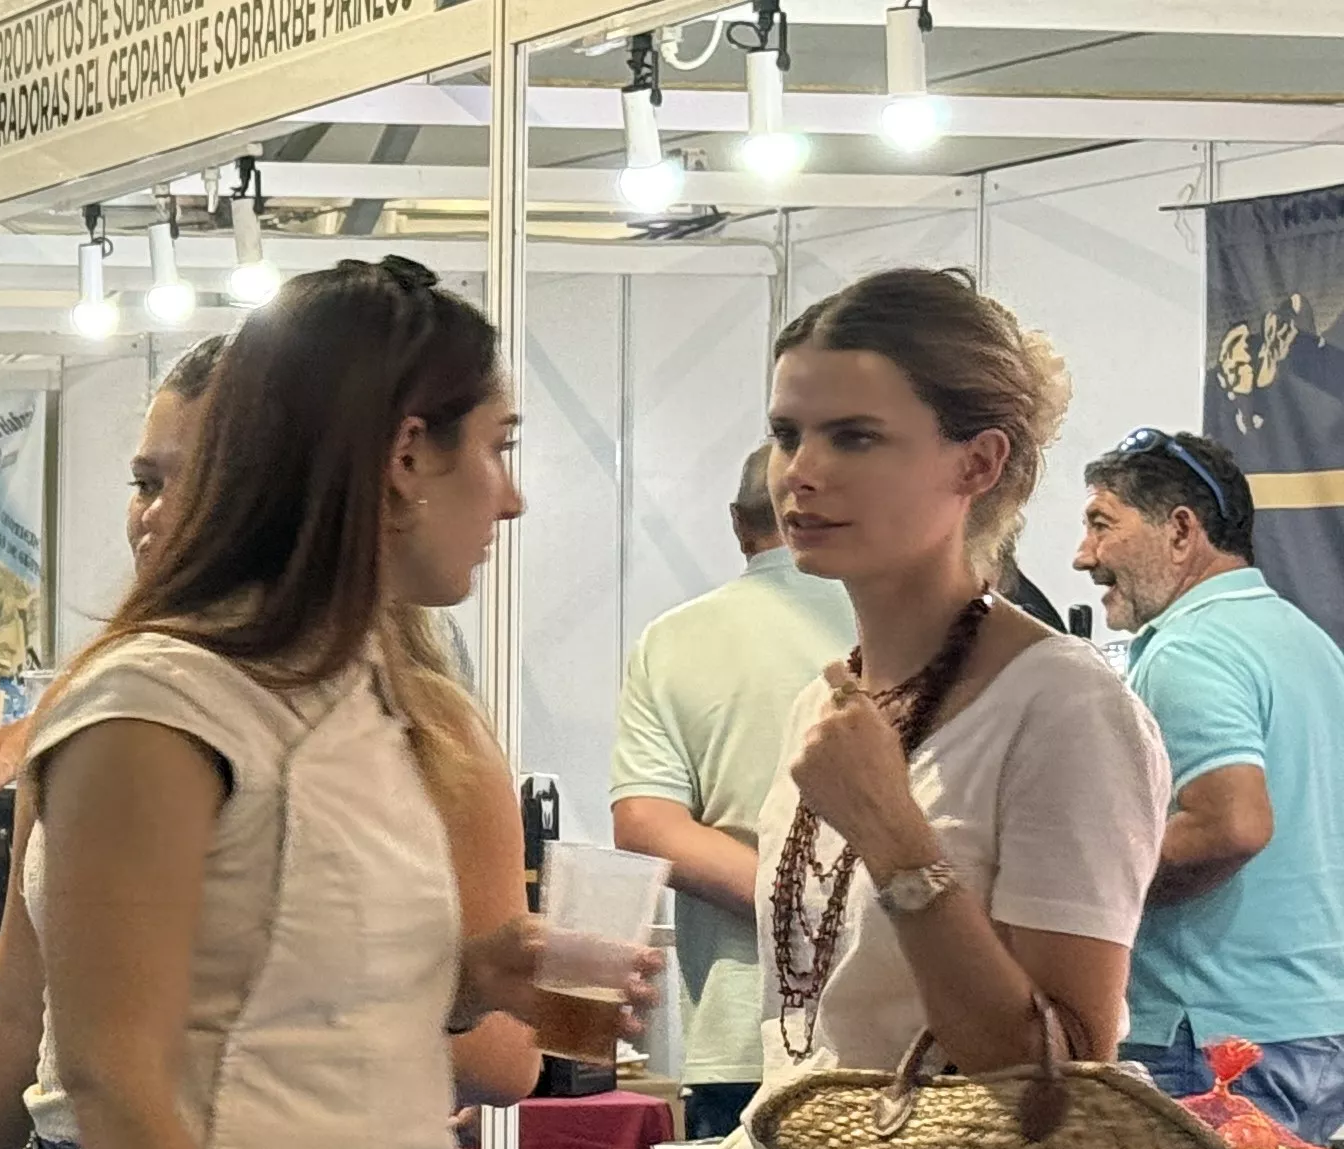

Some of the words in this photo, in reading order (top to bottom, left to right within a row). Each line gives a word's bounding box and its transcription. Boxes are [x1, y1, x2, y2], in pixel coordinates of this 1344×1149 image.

[74, 56, 103, 120] DEL
[107, 17, 209, 110] GEOPARQUE
[214, 0, 316, 74] SOBRARBE
[88, 0, 109, 49] DE
